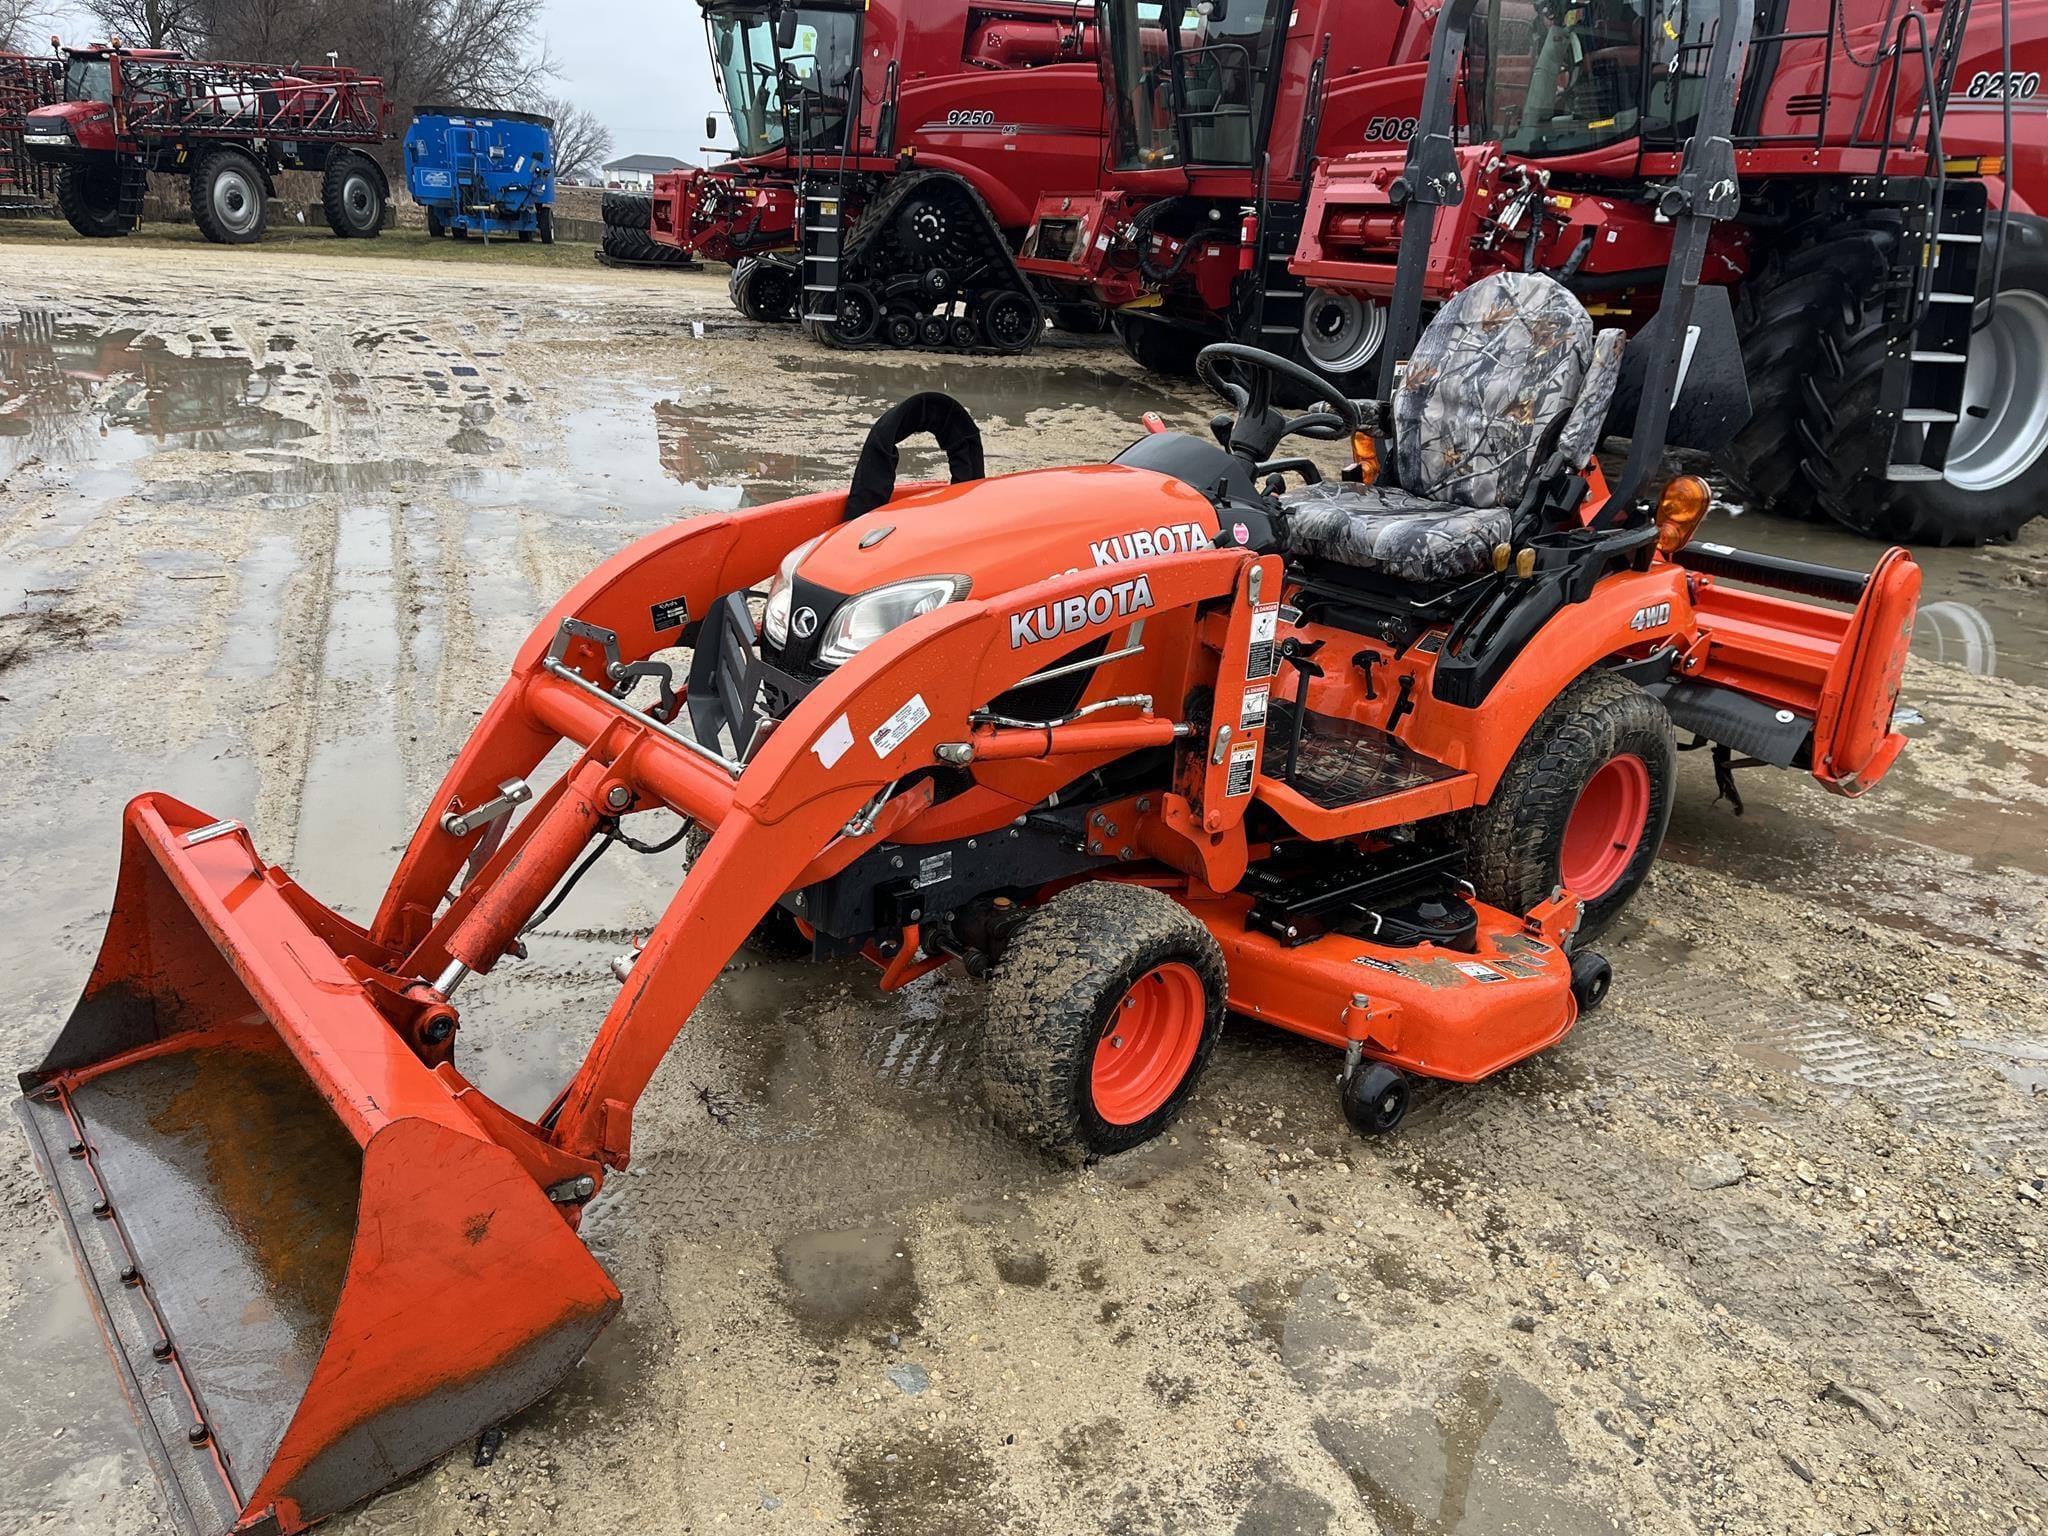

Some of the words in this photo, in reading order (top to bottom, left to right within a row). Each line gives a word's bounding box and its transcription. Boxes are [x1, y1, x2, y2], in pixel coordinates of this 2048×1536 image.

[1966, 71, 2041, 100] 8250
[948, 110, 994, 125] 9250
[1364, 117, 1420, 142] 508
[1090, 523, 1209, 566] KUBOTA
[1010, 576, 1154, 648] KUBOTA
[1629, 602, 1671, 632] 4WD
